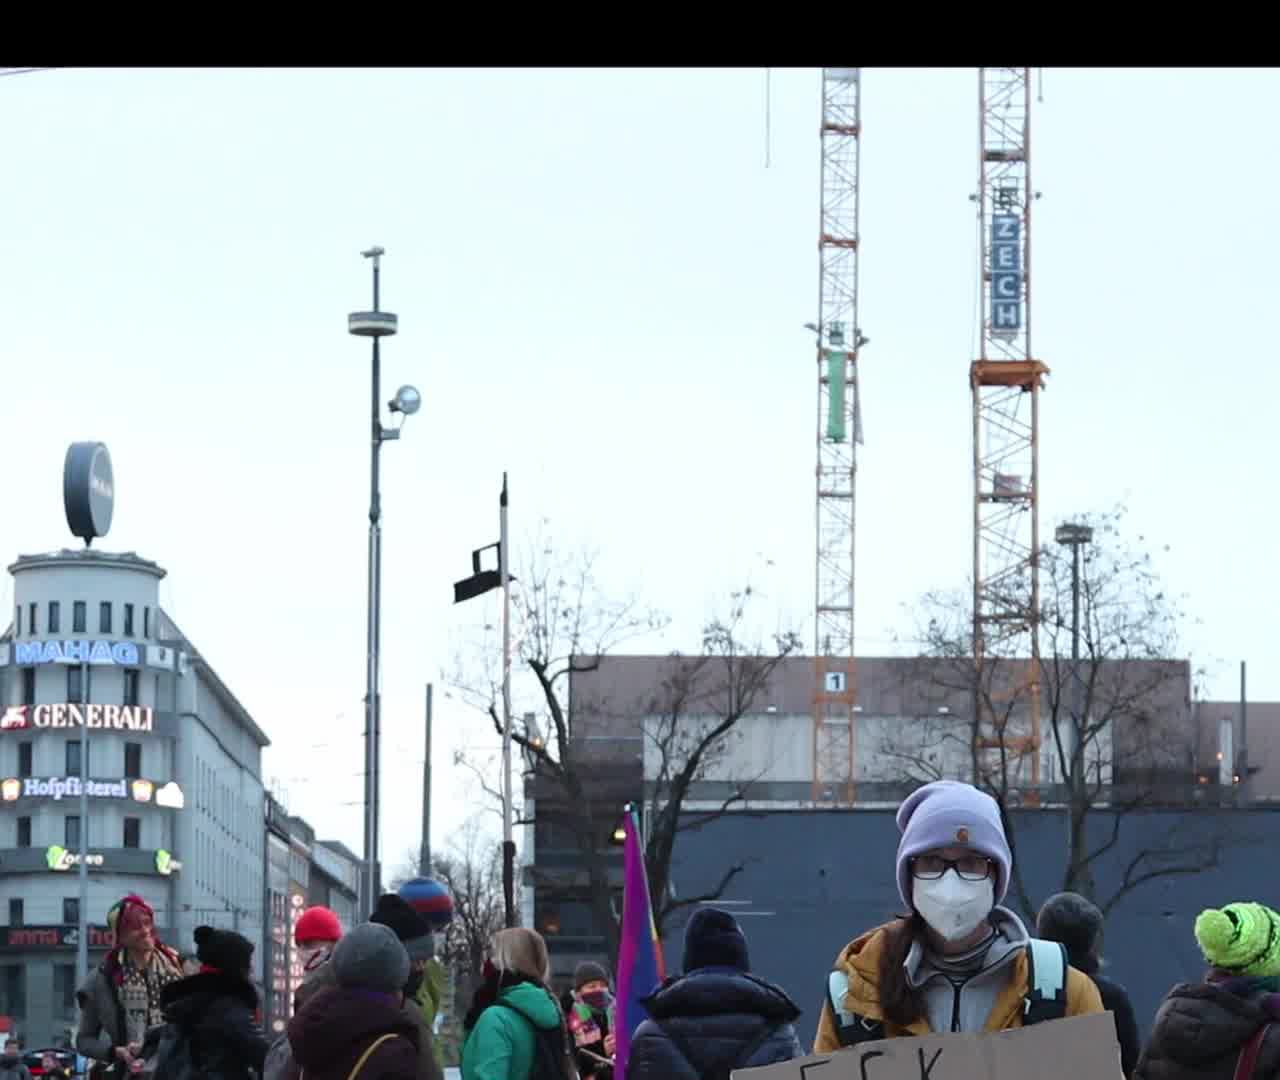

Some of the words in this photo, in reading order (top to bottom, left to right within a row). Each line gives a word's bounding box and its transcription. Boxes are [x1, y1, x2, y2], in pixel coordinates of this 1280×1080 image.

[997, 217, 1018, 325] ZECH
[831, 674, 840, 689] 1
[33, 703, 153, 732] GENERALI
